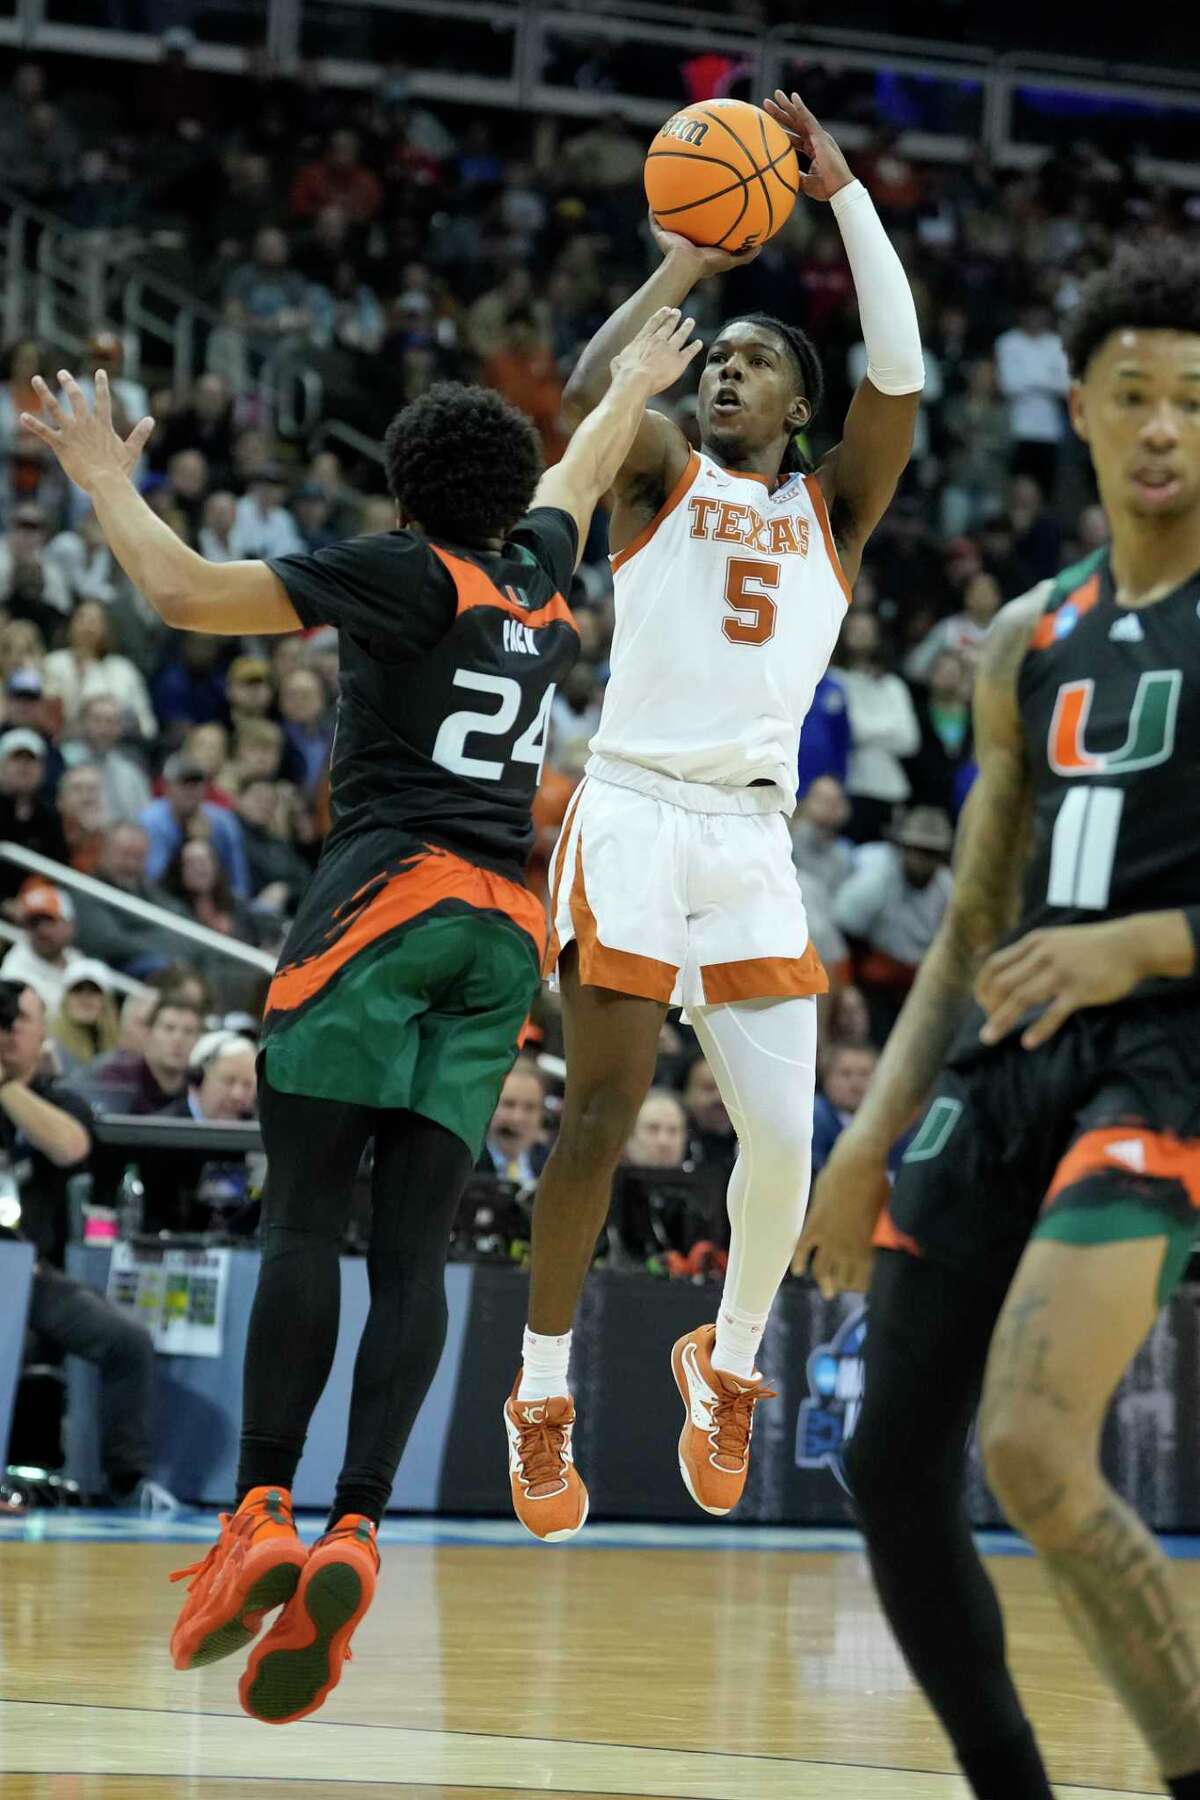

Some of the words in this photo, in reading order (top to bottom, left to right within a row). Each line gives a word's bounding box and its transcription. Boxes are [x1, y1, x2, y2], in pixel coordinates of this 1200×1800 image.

[688, 495, 810, 560] TEXAS
[721, 556, 781, 647] 5
[432, 668, 556, 786] 24
[1048, 670, 1182, 777] U
[1046, 786, 1124, 910] 11
